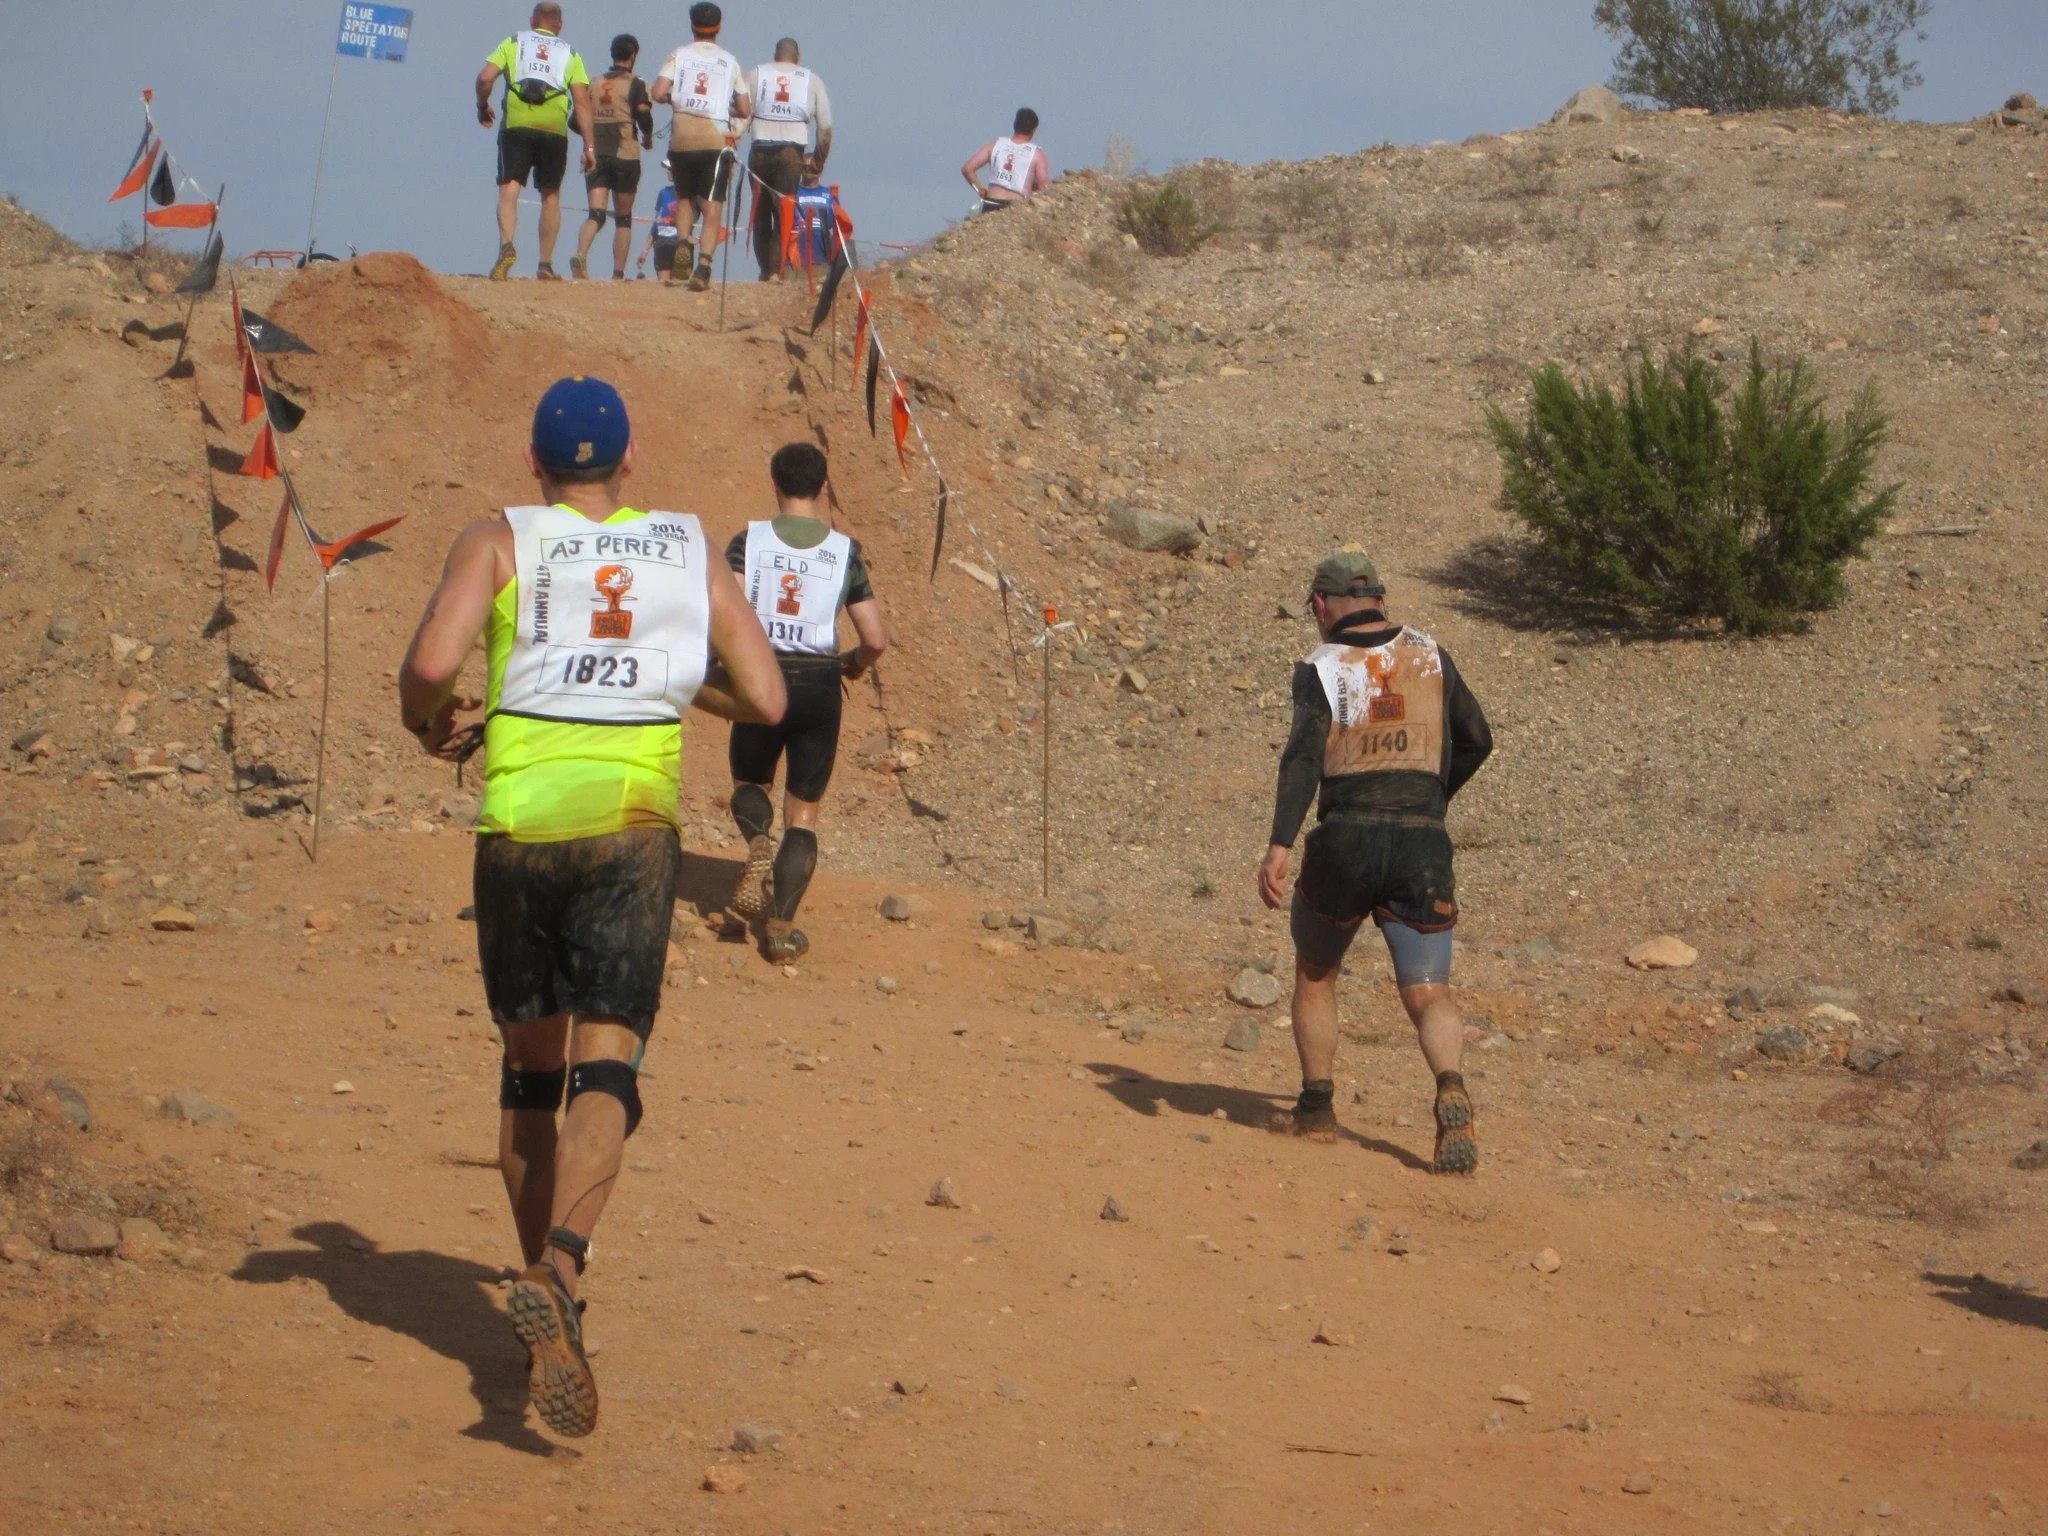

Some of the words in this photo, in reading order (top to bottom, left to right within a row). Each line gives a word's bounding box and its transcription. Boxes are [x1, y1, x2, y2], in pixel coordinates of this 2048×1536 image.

[345, 5, 374, 21] BLUE
[341, 31, 377, 48] ROUTE
[344, 19, 409, 40] SPECTATOR
[686, 98, 708, 110] 1077
[771, 104, 791, 114] 2044
[649, 523, 685, 535] 2014
[550, 539, 584, 560] AJ
[595, 535, 673, 560] PEREZ
[818, 548, 837, 560] 2014
[773, 555, 809, 574] ELD
[536, 565, 551, 588] 4TH
[532, 590, 551, 645] ANNUAL
[767, 621, 804, 643] 1311
[562, 653, 639, 689] 1823
[1360, 728, 1408, 755] 1140
